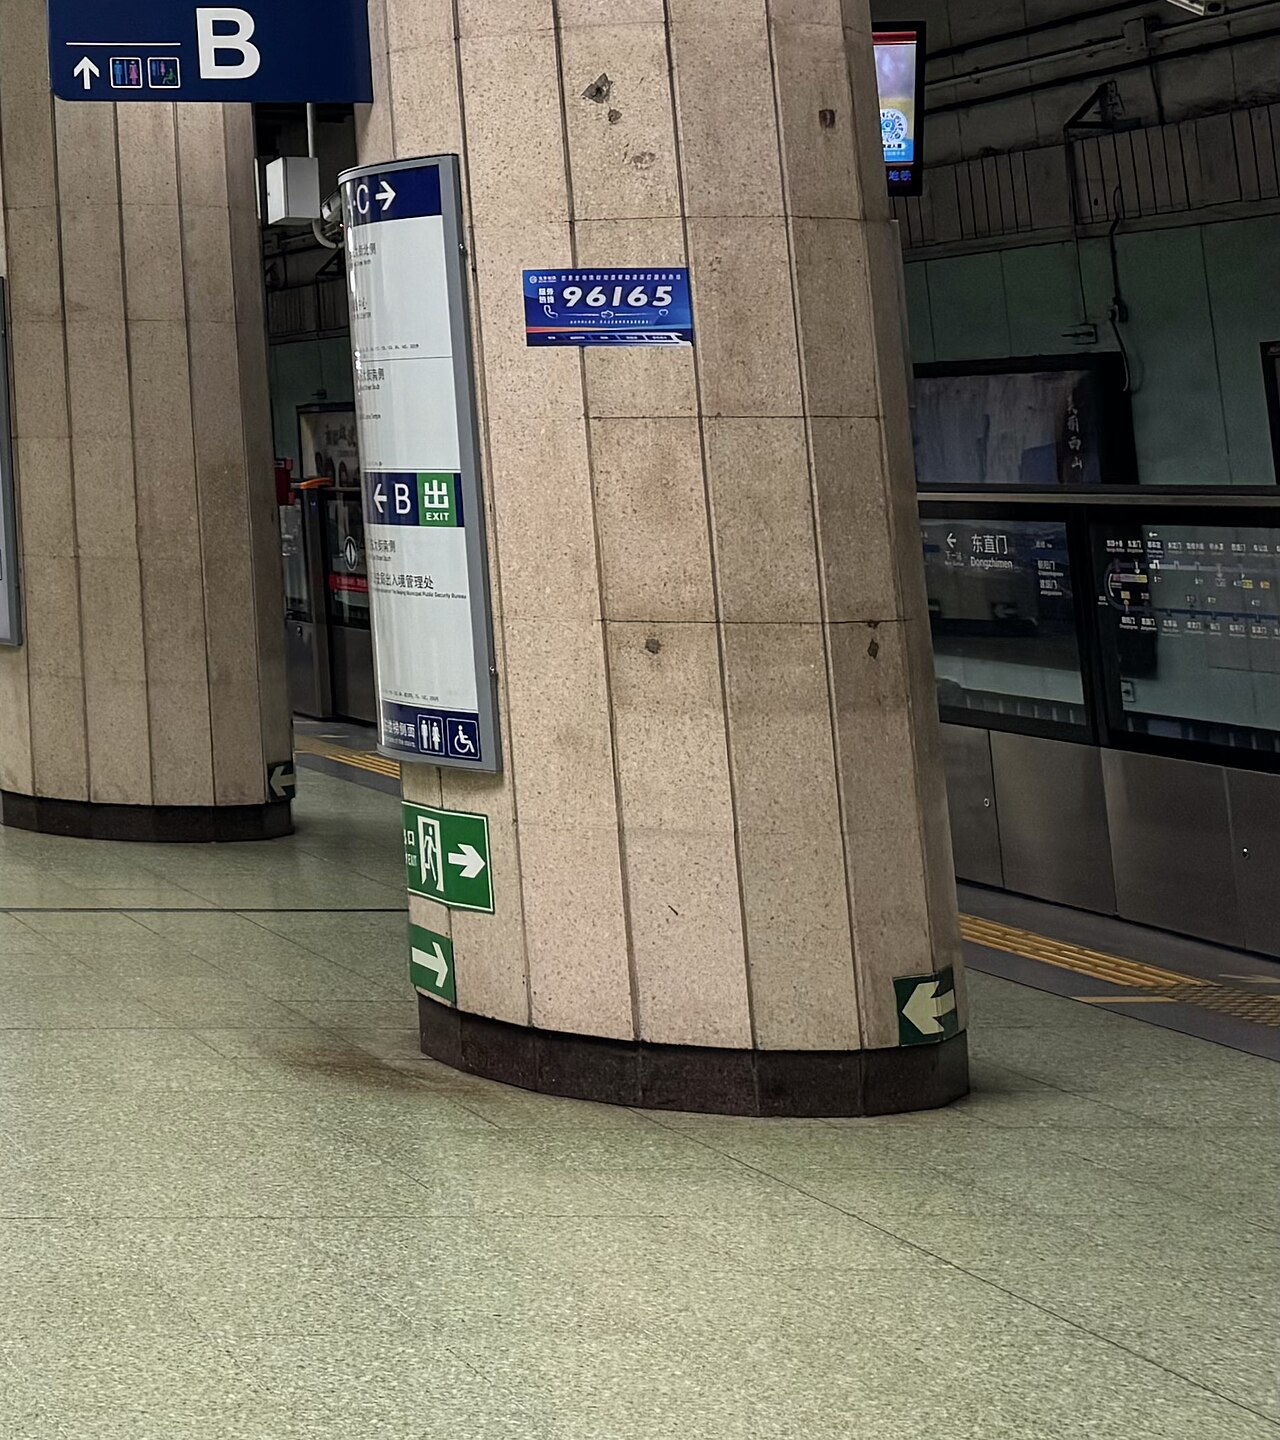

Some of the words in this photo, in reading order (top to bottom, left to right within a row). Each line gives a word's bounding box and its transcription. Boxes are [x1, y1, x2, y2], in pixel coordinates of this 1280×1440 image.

[195, 7, 261, 80] B
[562, 285, 673, 308] 96165
[394, 483, 412, 515] B
[426, 512, 450, 521] EXIT
[971, 533, 1009, 554] 东直门
[970, 556, 1013, 570] Dongzhimen
